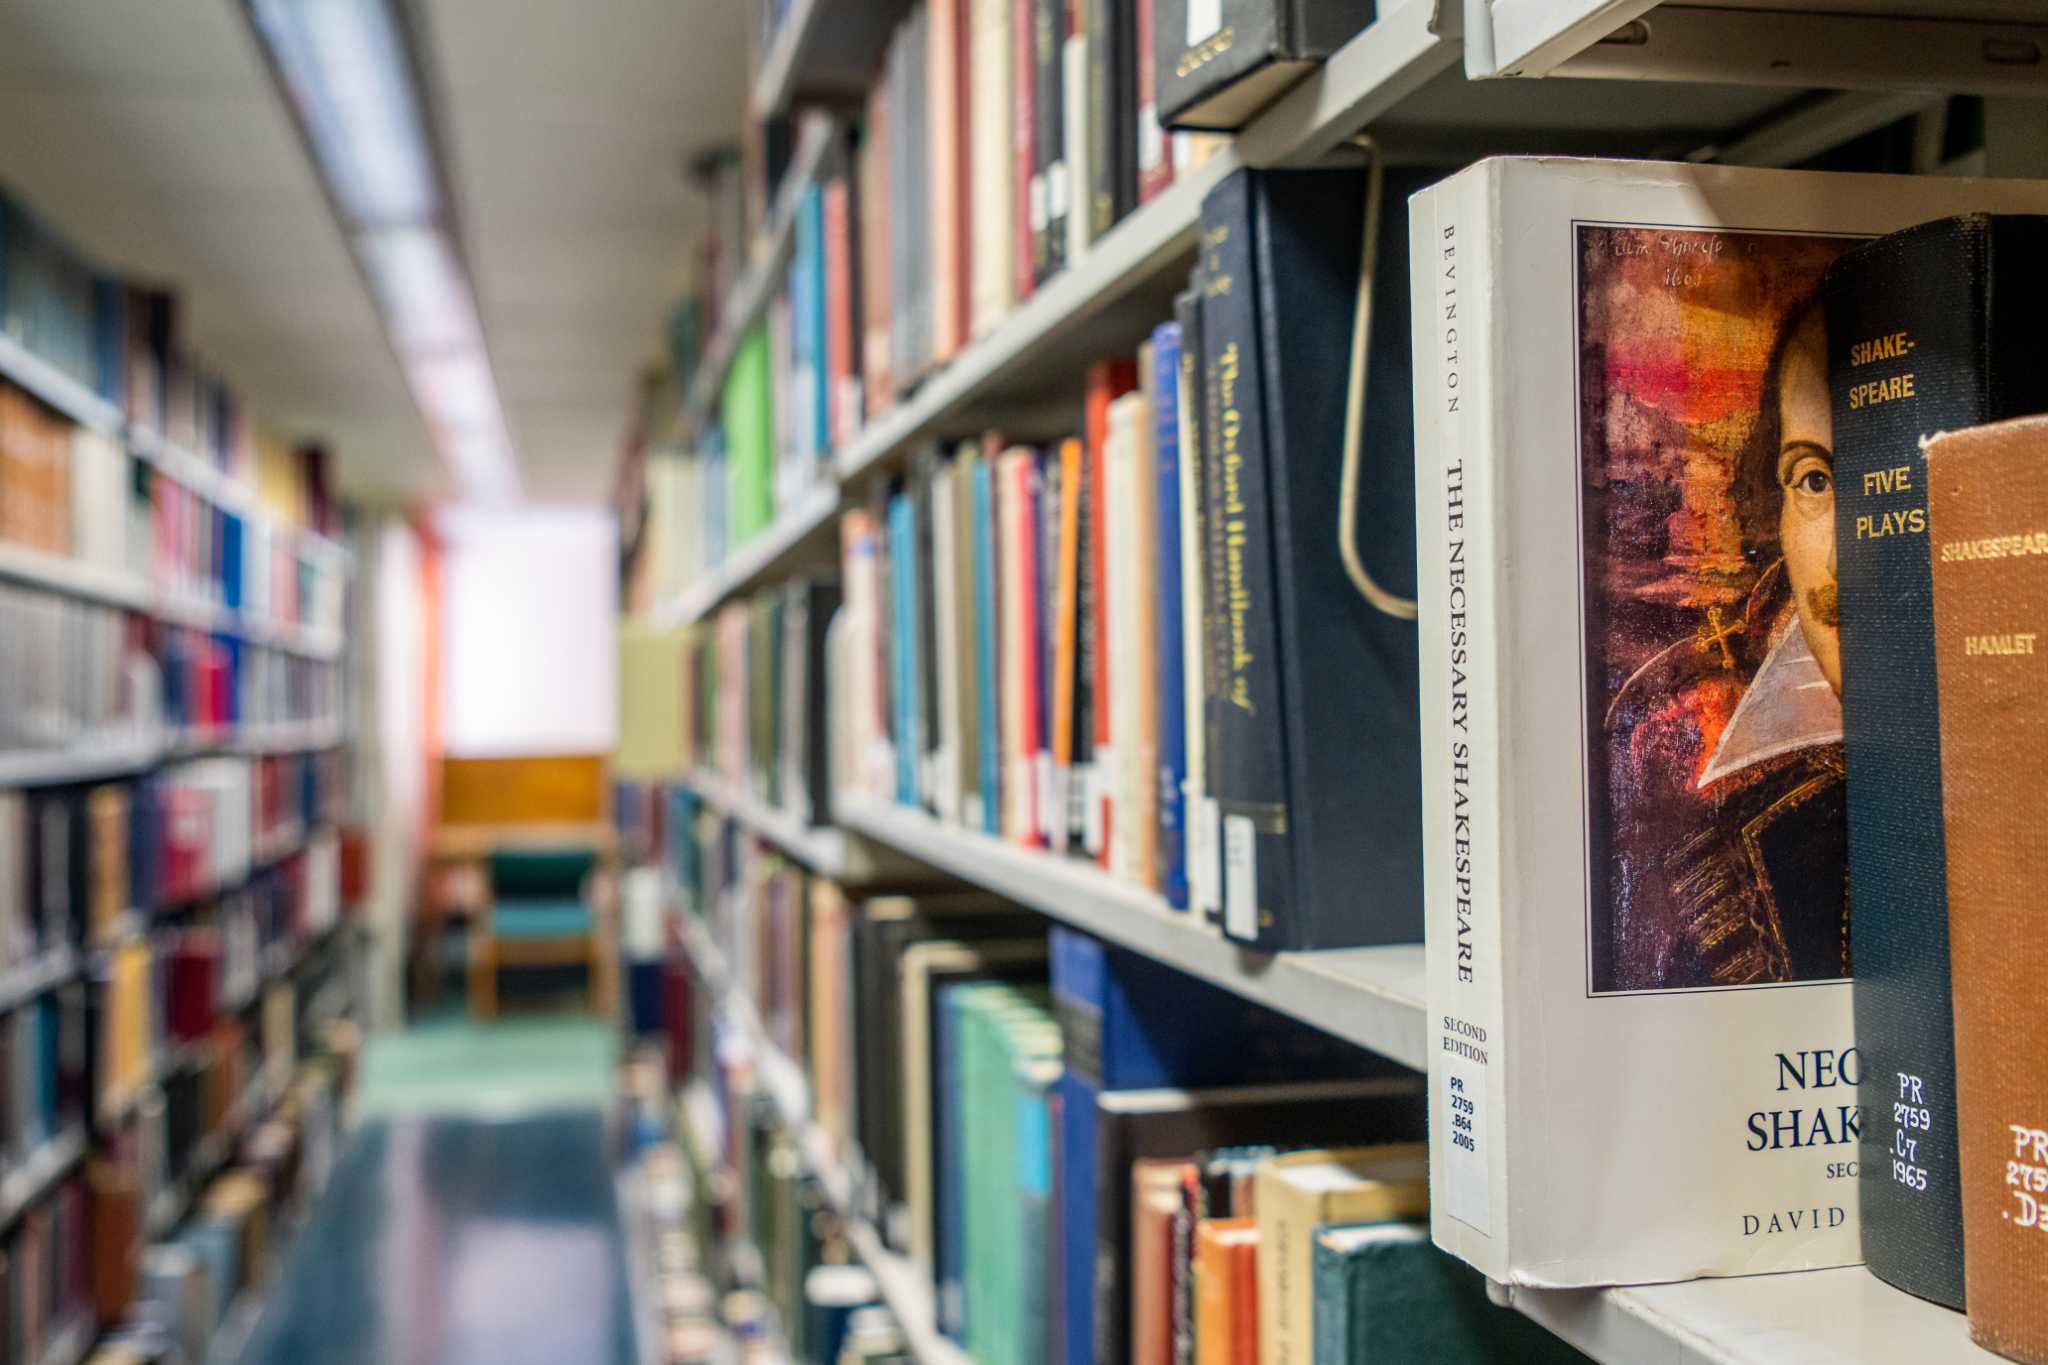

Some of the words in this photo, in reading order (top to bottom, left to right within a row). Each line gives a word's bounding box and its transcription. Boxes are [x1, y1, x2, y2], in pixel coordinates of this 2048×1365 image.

[1443, 225, 1460, 413] BEVINGTON
[1851, 331, 1915, 367] SHAKE-
[1849, 373, 1915, 410] SPEARE
[1447, 458, 1465, 532] THE
[1863, 466, 1912, 496] FIVE
[1856, 508, 1926, 539] PLAYS
[1448, 540, 1469, 734] NECESSARY
[1965, 632, 2037, 656] HAMLET
[1453, 742, 1473, 983] SHAKESPEARE
[1443, 1016, 1487, 1043] SECOND
[1443, 1036, 1488, 1064] EDITION
[1450, 1076, 1464, 1093] PR
[1897, 1072, 1923, 1104] PR
[1451, 1094, 1474, 1115] 2759
[1893, 1102, 1931, 1131] 2759
[1452, 1113, 1472, 1132] .B64
[1453, 1130, 1475, 1152] 2005
[1889, 1128, 1917, 1162] .C7
[2008, 1124, 2048, 1166] PR
[1892, 1159, 1928, 1191] 1965
[1742, 1207, 1845, 1235] DAVID
